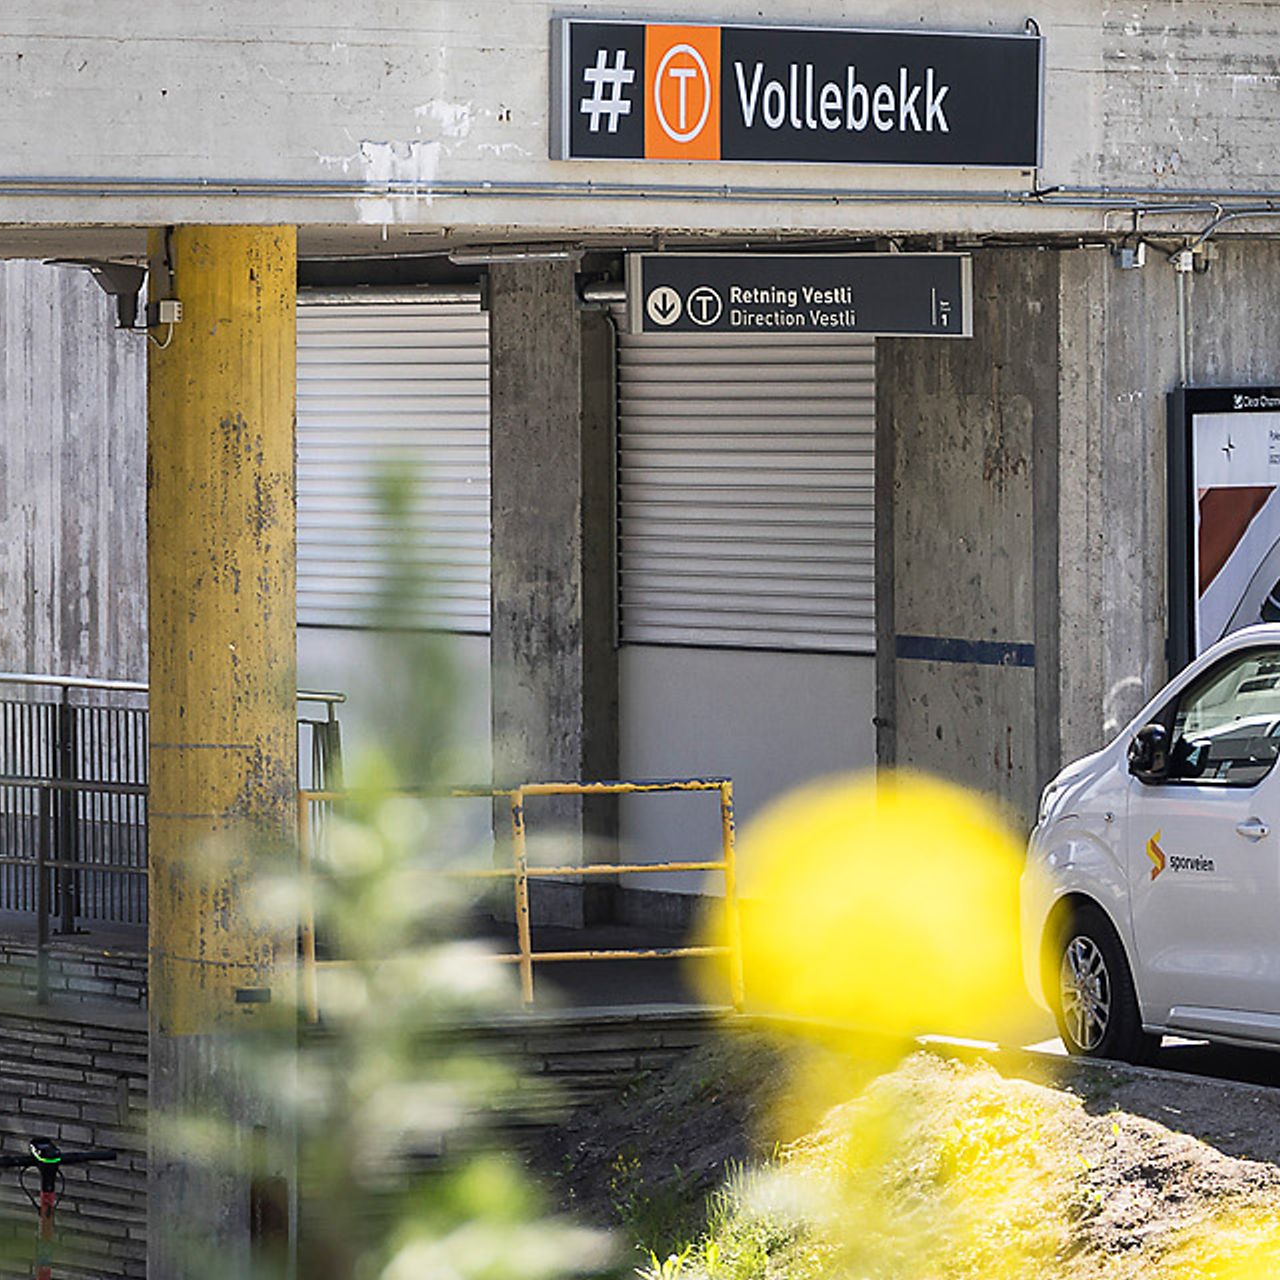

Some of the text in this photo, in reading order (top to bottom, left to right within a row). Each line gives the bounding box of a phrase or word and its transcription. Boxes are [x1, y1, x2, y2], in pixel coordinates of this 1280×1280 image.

[733, 61, 951, 133] Vollebekk
[729, 285, 797, 308] Retning
[801, 285, 852, 304] Vestli
[729, 309, 856, 327] Direction Vestli
[1169, 853, 1215, 873] sporveien
